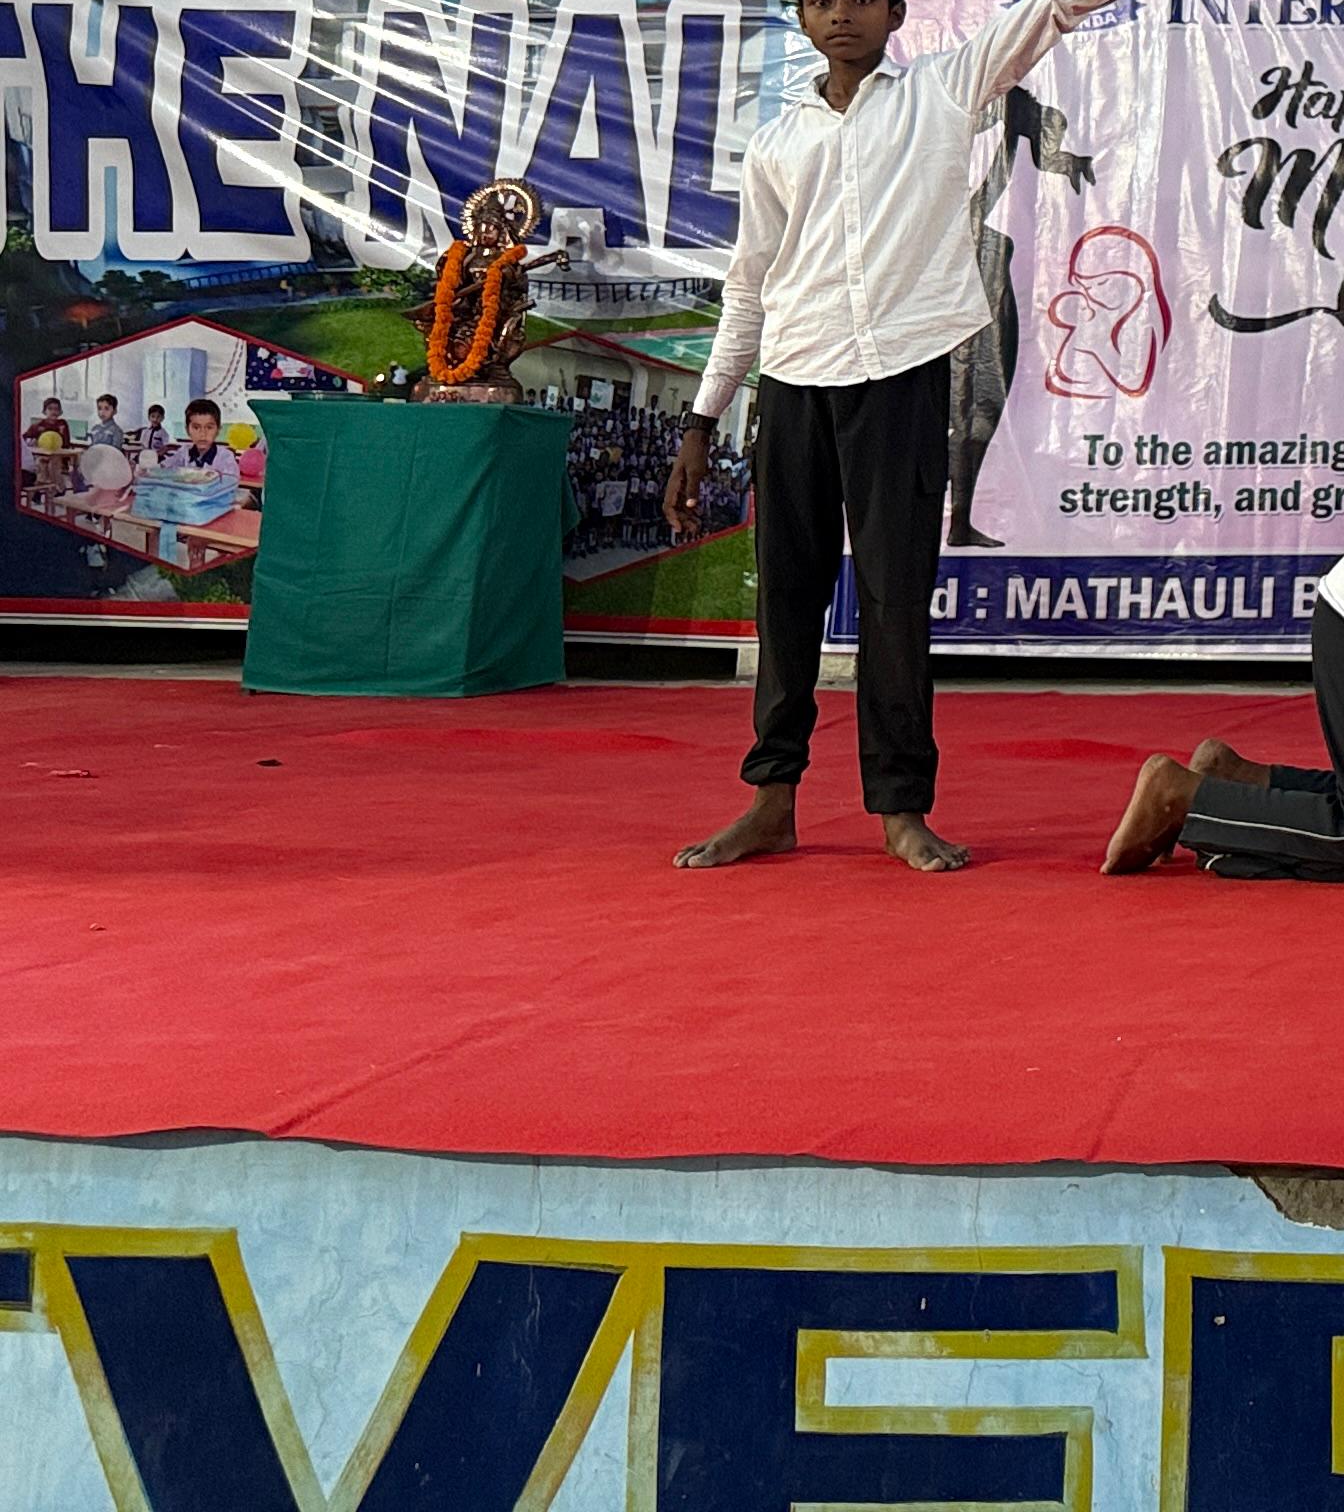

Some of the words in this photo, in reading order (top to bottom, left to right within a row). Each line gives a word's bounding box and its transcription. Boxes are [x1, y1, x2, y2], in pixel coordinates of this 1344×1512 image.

[0, 3, 298, 237] HE
[1083, 435, 1124, 466] To
[1134, 435, 1193, 466] the
[1059, 481, 1224, 519] strength,
[1234, 481, 1301, 512] and
[1006, 577, 1273, 620] MATHAULI
